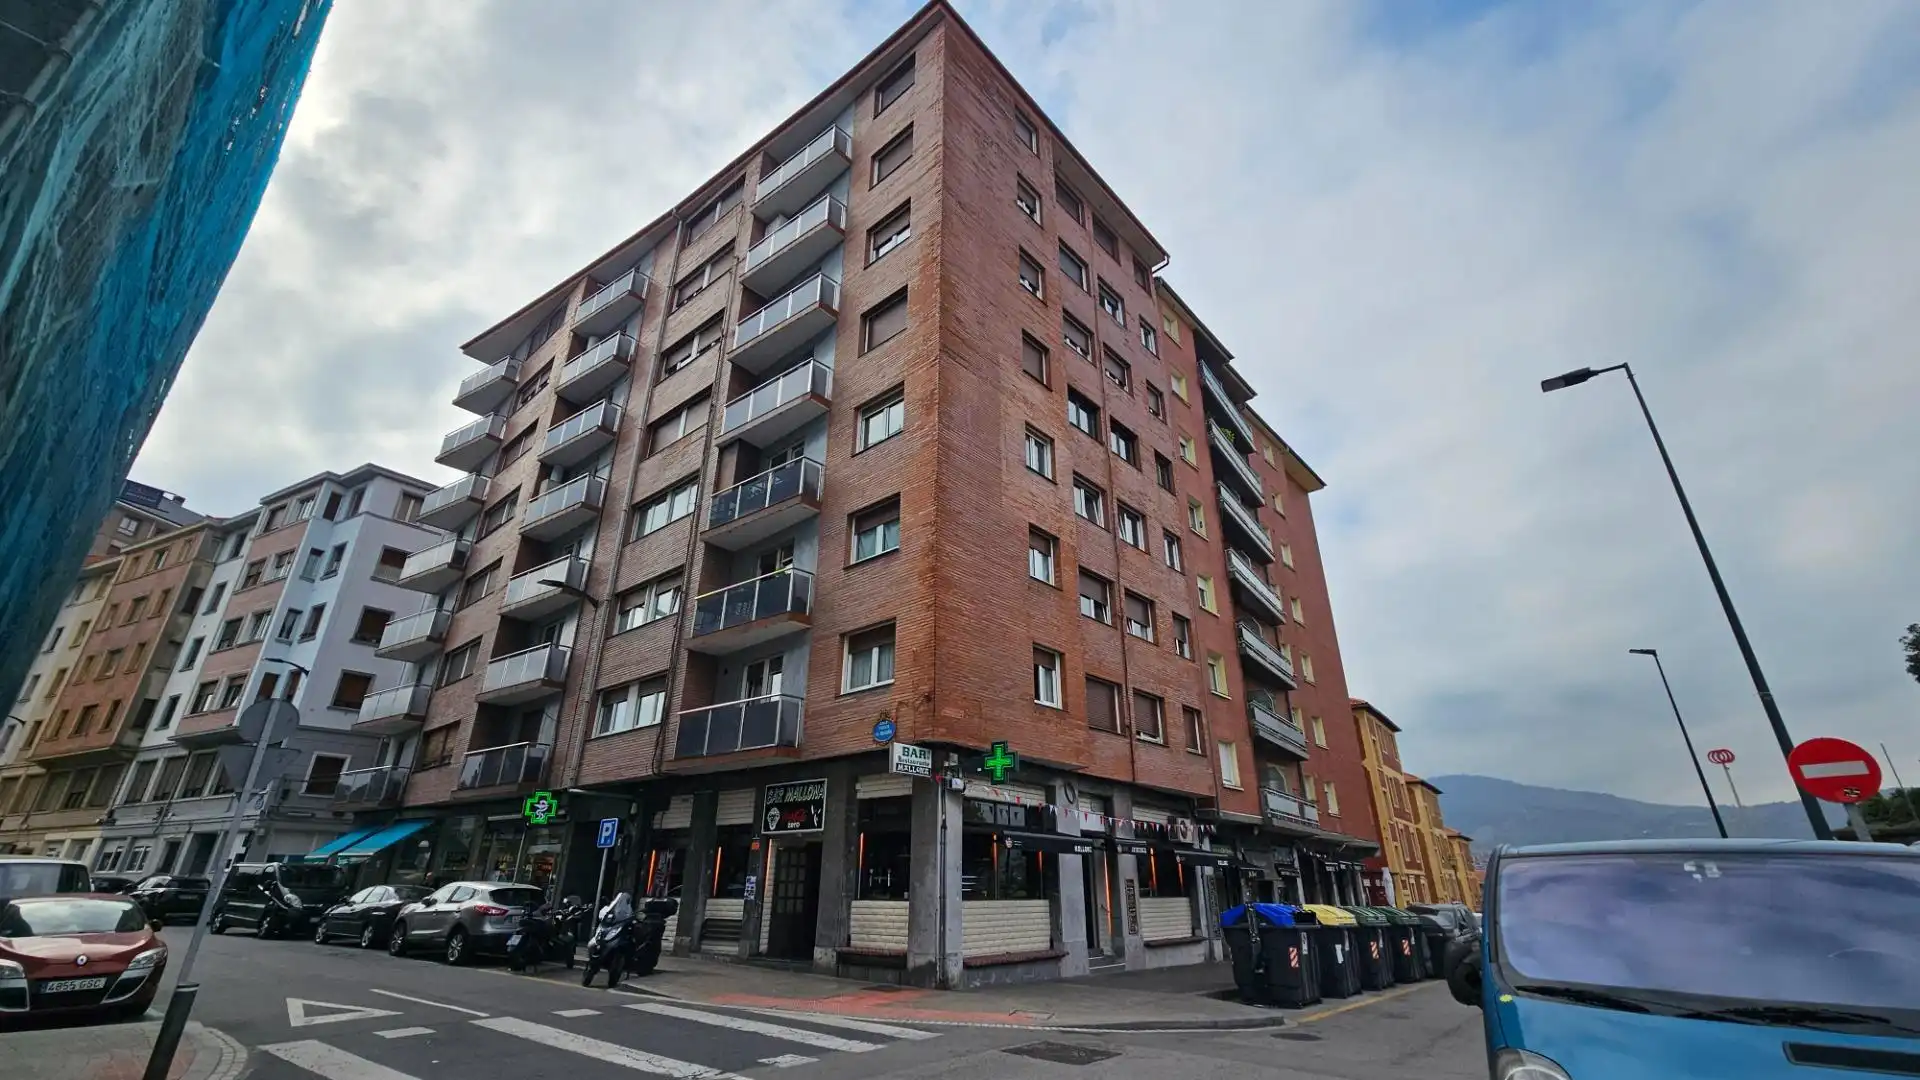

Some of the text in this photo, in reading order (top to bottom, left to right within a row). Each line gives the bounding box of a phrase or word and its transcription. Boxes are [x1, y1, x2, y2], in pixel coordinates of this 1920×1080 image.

[902, 746, 926, 759] BAR
[767, 784, 825, 804] BAR MALLONA
[601, 821, 613, 844] P
